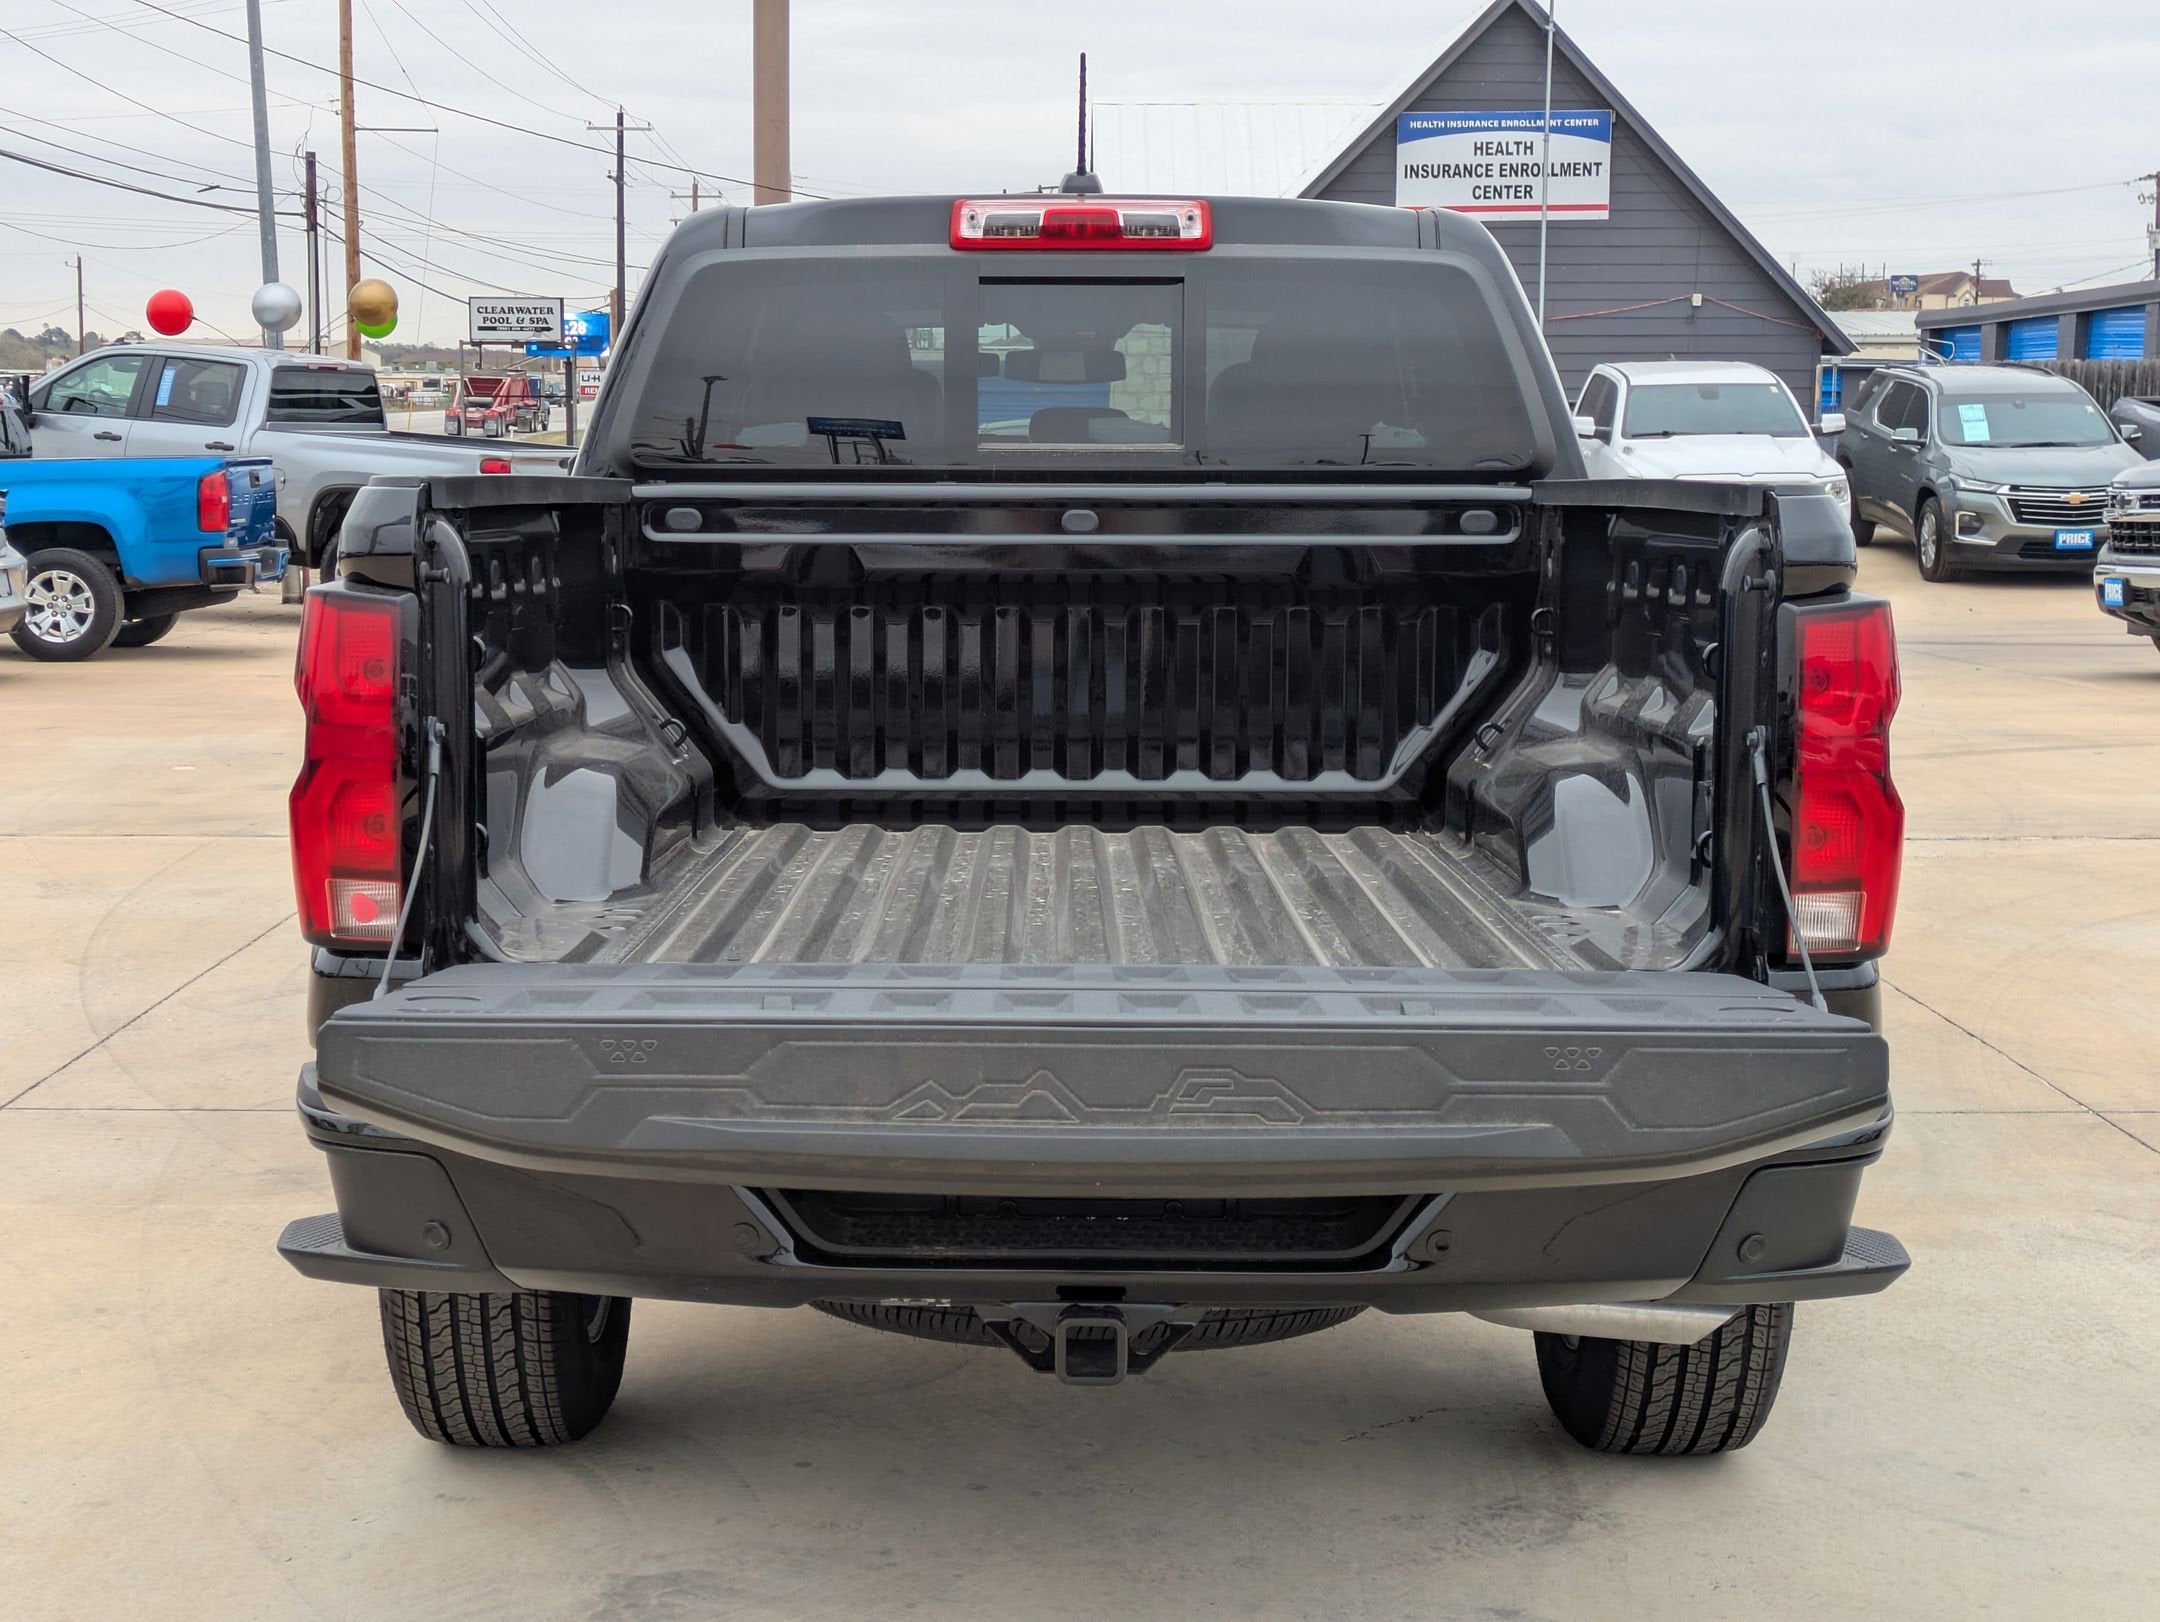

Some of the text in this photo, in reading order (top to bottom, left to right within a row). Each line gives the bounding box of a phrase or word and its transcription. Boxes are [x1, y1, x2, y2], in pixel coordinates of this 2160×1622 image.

[1410, 118, 1599, 129] HEALTH INSURANCE ENROLLMNT CENTER
[1473, 141, 1534, 156] HEALTH
[1404, 163, 1494, 179] INSURANCE
[1472, 185, 1533, 200] CENTER
[476, 306, 554, 315] CLEARWATER
[482, 316, 549, 325] POOL & SPA
[2058, 533, 2091, 545] PRICE
